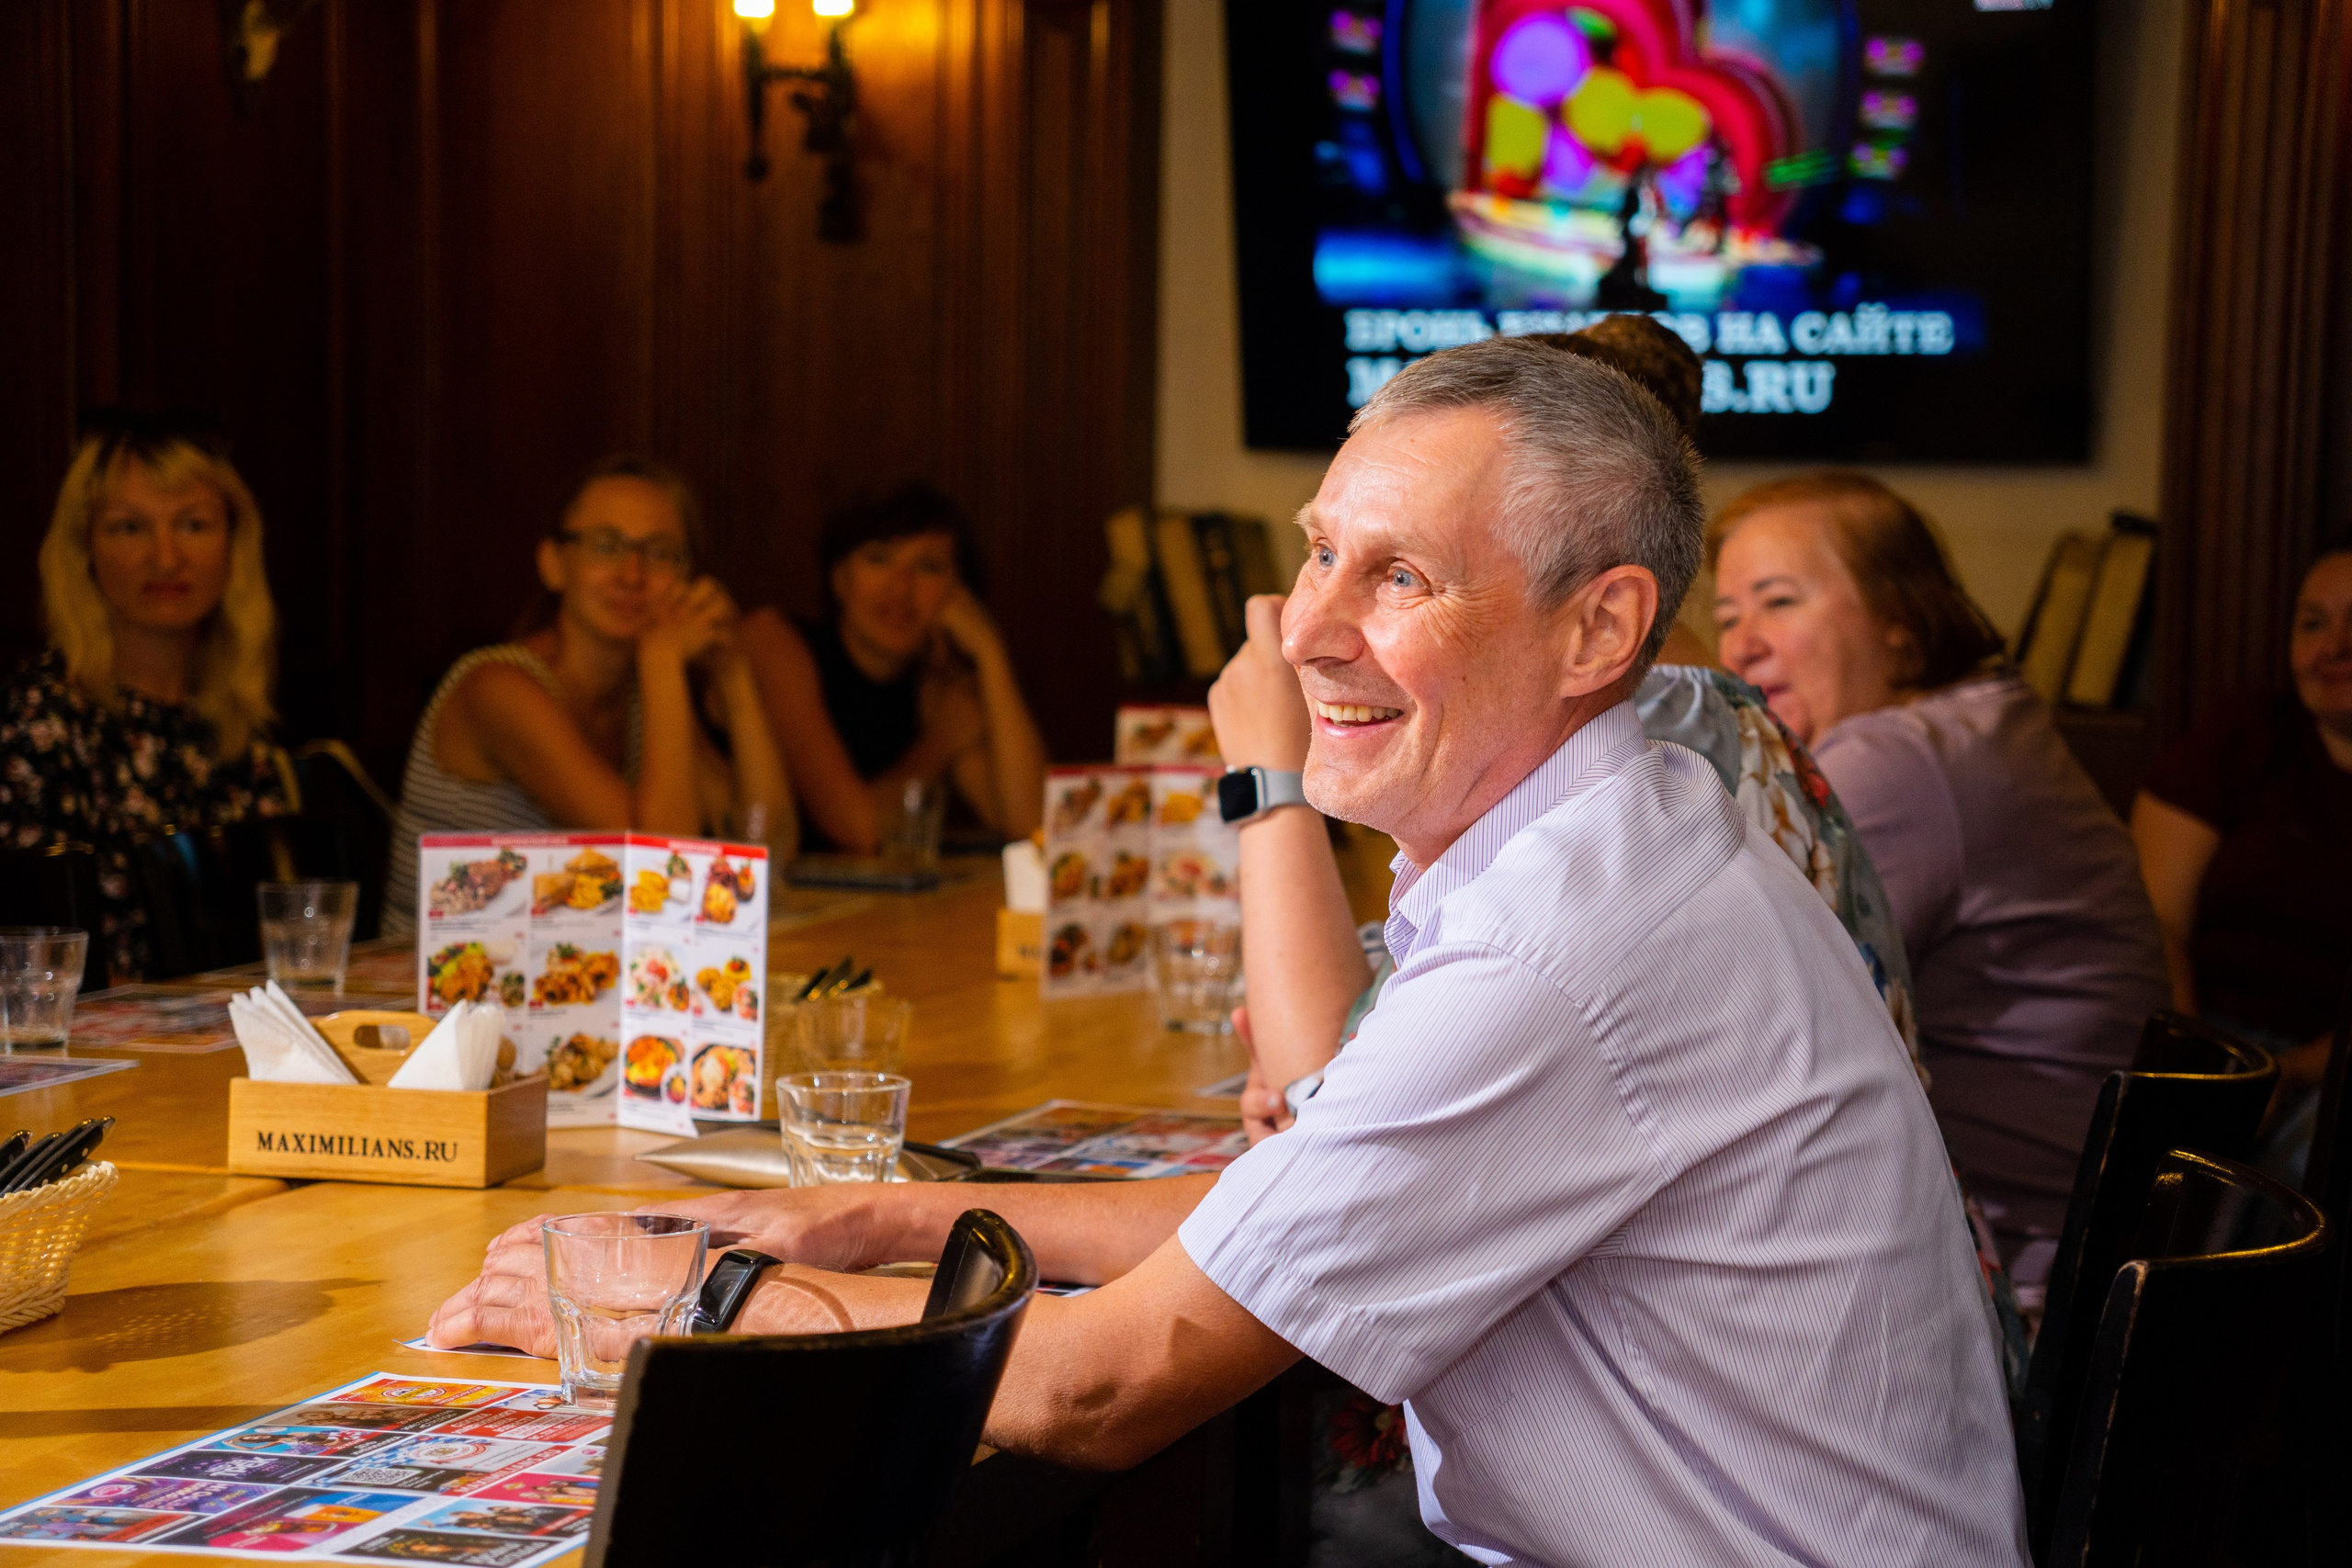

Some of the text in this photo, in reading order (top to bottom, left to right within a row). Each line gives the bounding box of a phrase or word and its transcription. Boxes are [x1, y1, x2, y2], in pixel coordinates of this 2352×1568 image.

[1715, 310, 1789, 355] НА
[1790, 301, 1954, 355] САЙТЕ
[257, 1131, 458, 1163] MAXIMILIANS.RU
